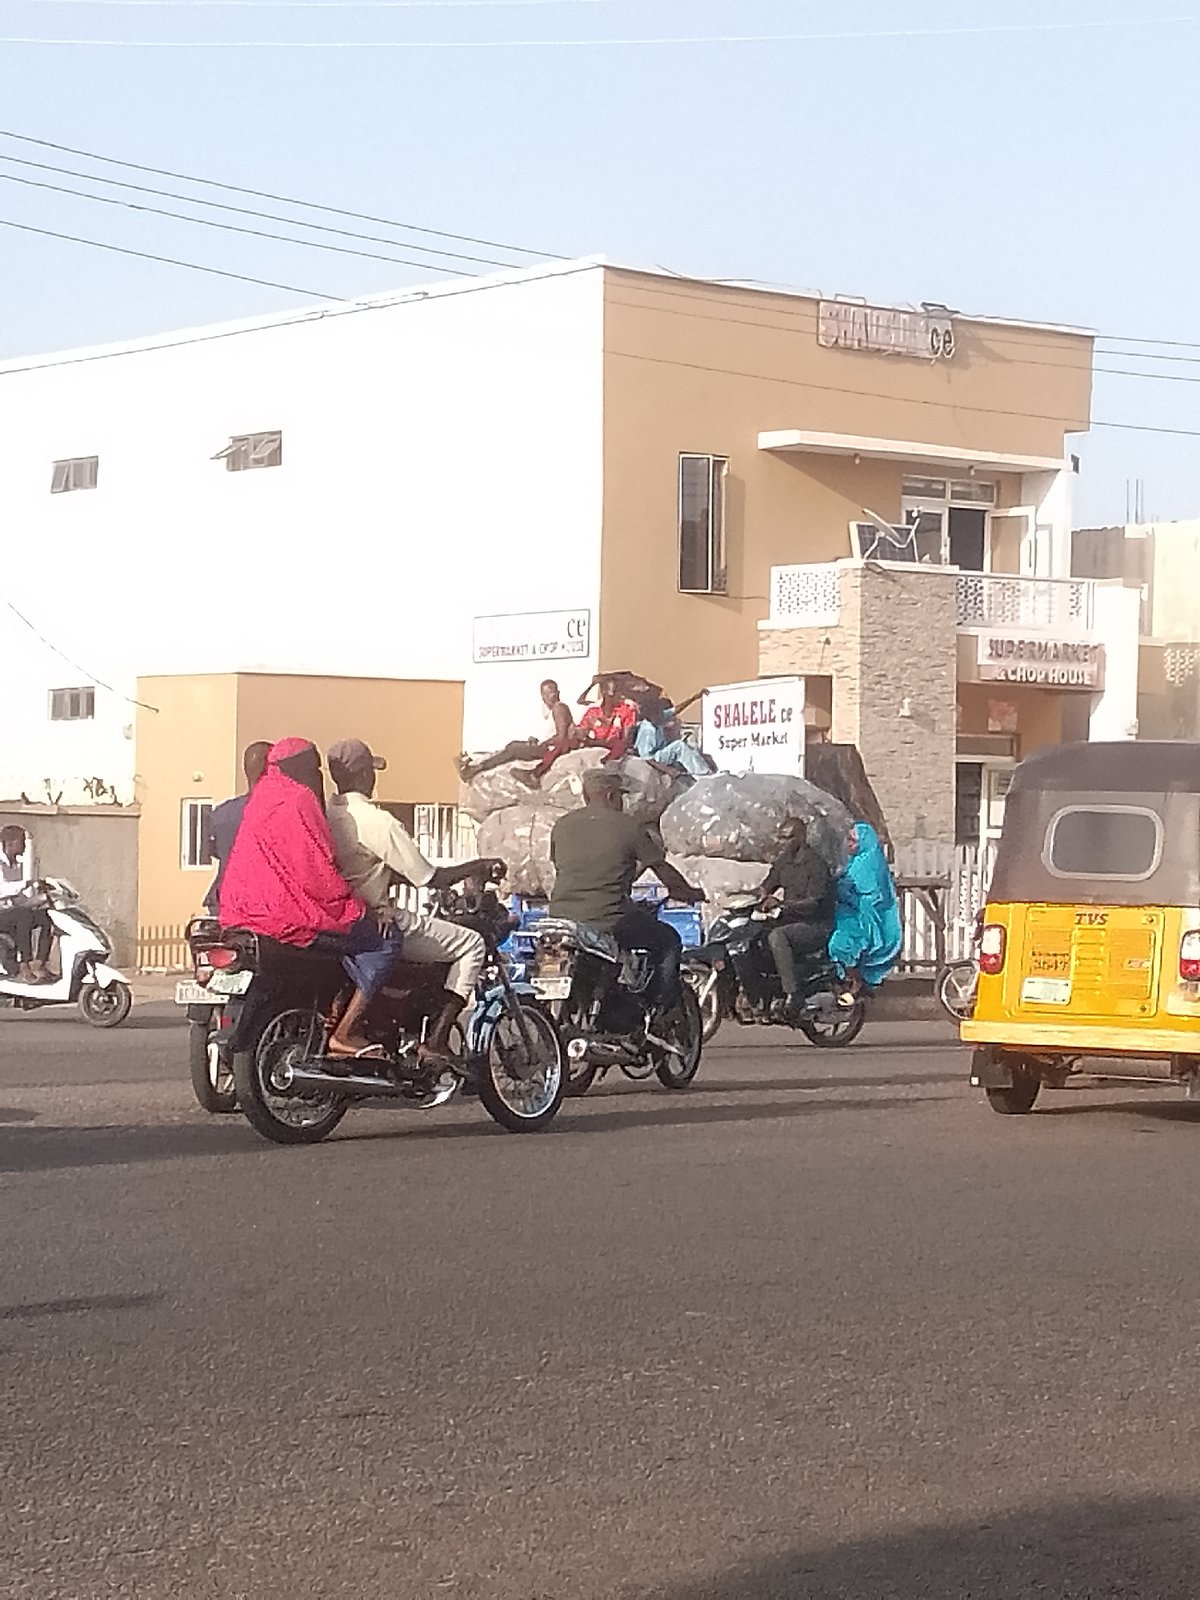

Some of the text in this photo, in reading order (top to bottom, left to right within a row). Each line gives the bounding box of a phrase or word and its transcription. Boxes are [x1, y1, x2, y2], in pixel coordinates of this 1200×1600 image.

[988, 638, 1099, 663] SUPERMARKET
[1008, 667, 1046, 682] CHOP
[1048, 668, 1092, 685] HOUSE
[714, 699, 776, 729] SHALELE
[718, 731, 788, 751] Super Market
[1075, 913, 1109, 926] TVS
